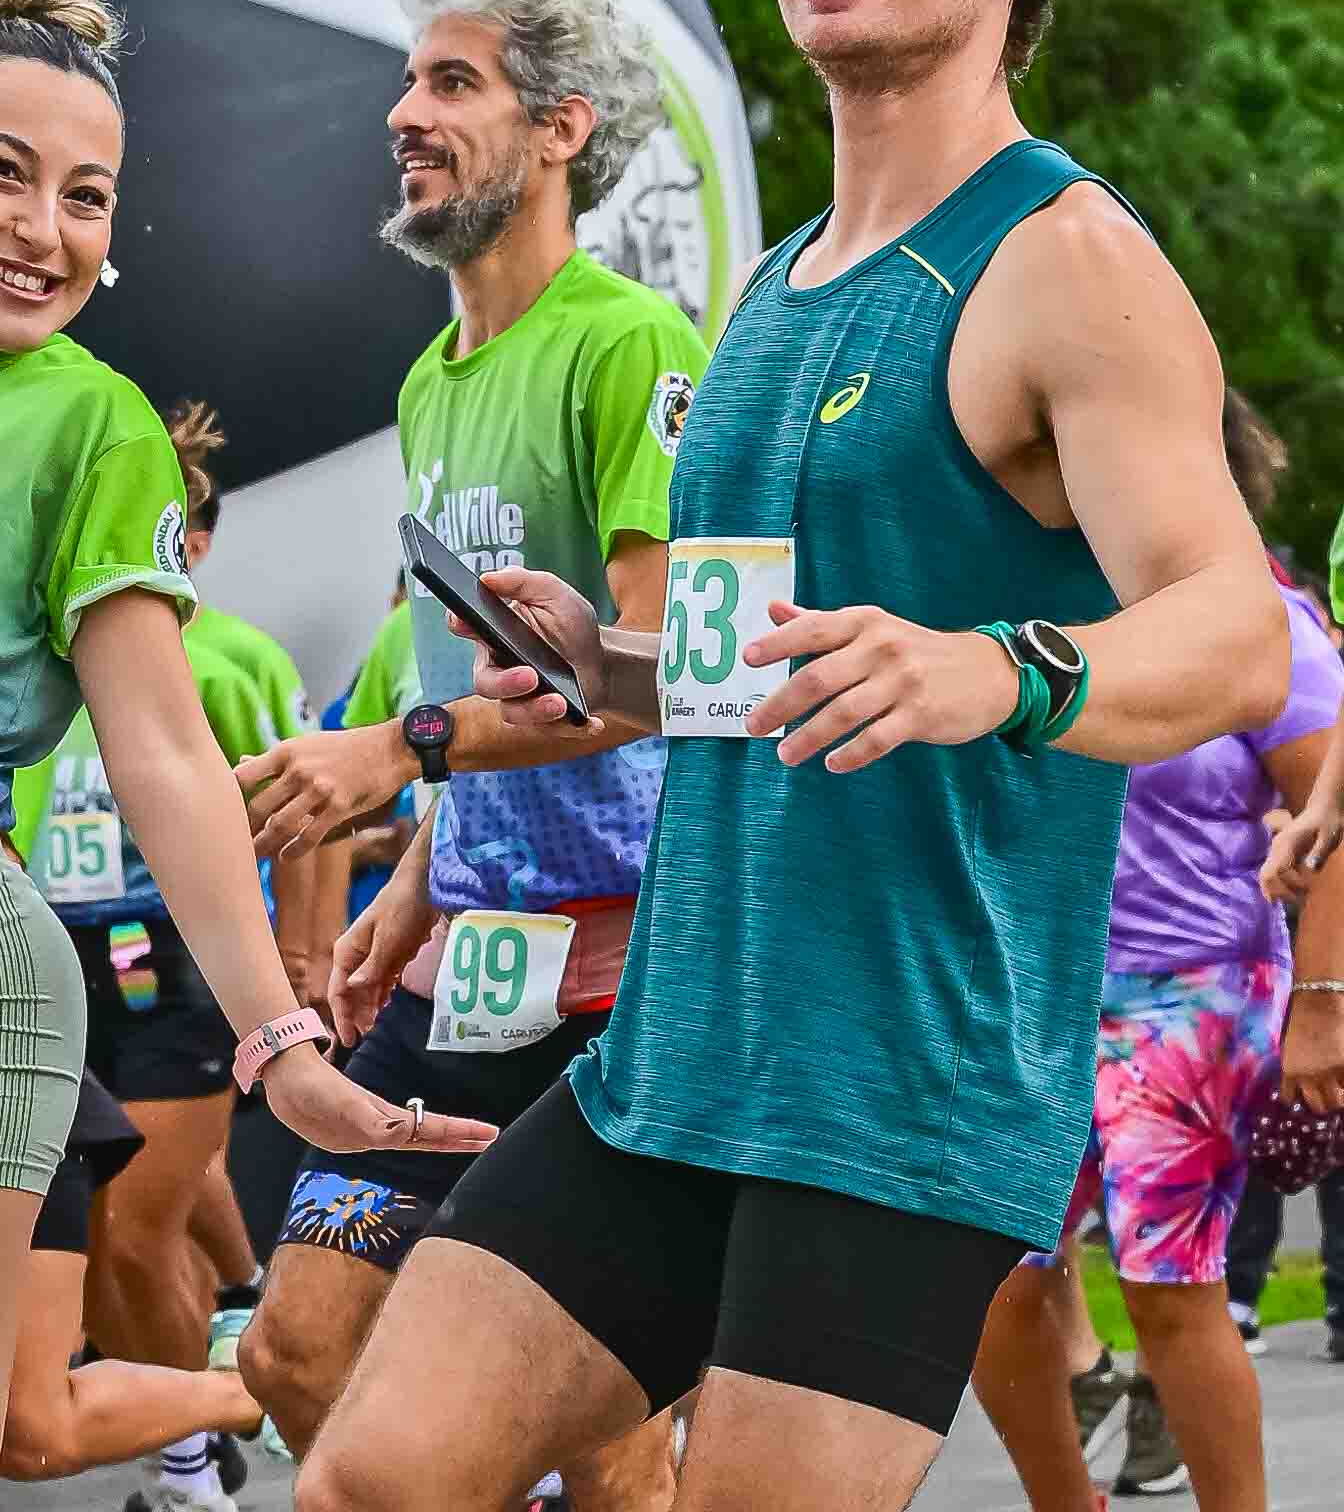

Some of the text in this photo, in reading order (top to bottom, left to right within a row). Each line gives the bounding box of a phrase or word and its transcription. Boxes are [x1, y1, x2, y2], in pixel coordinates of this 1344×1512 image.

[462, 485, 525, 550] Ville
[664, 558, 740, 685] 53
[707, 701, 755, 719] CARUS
[450, 925, 529, 1017] 99
